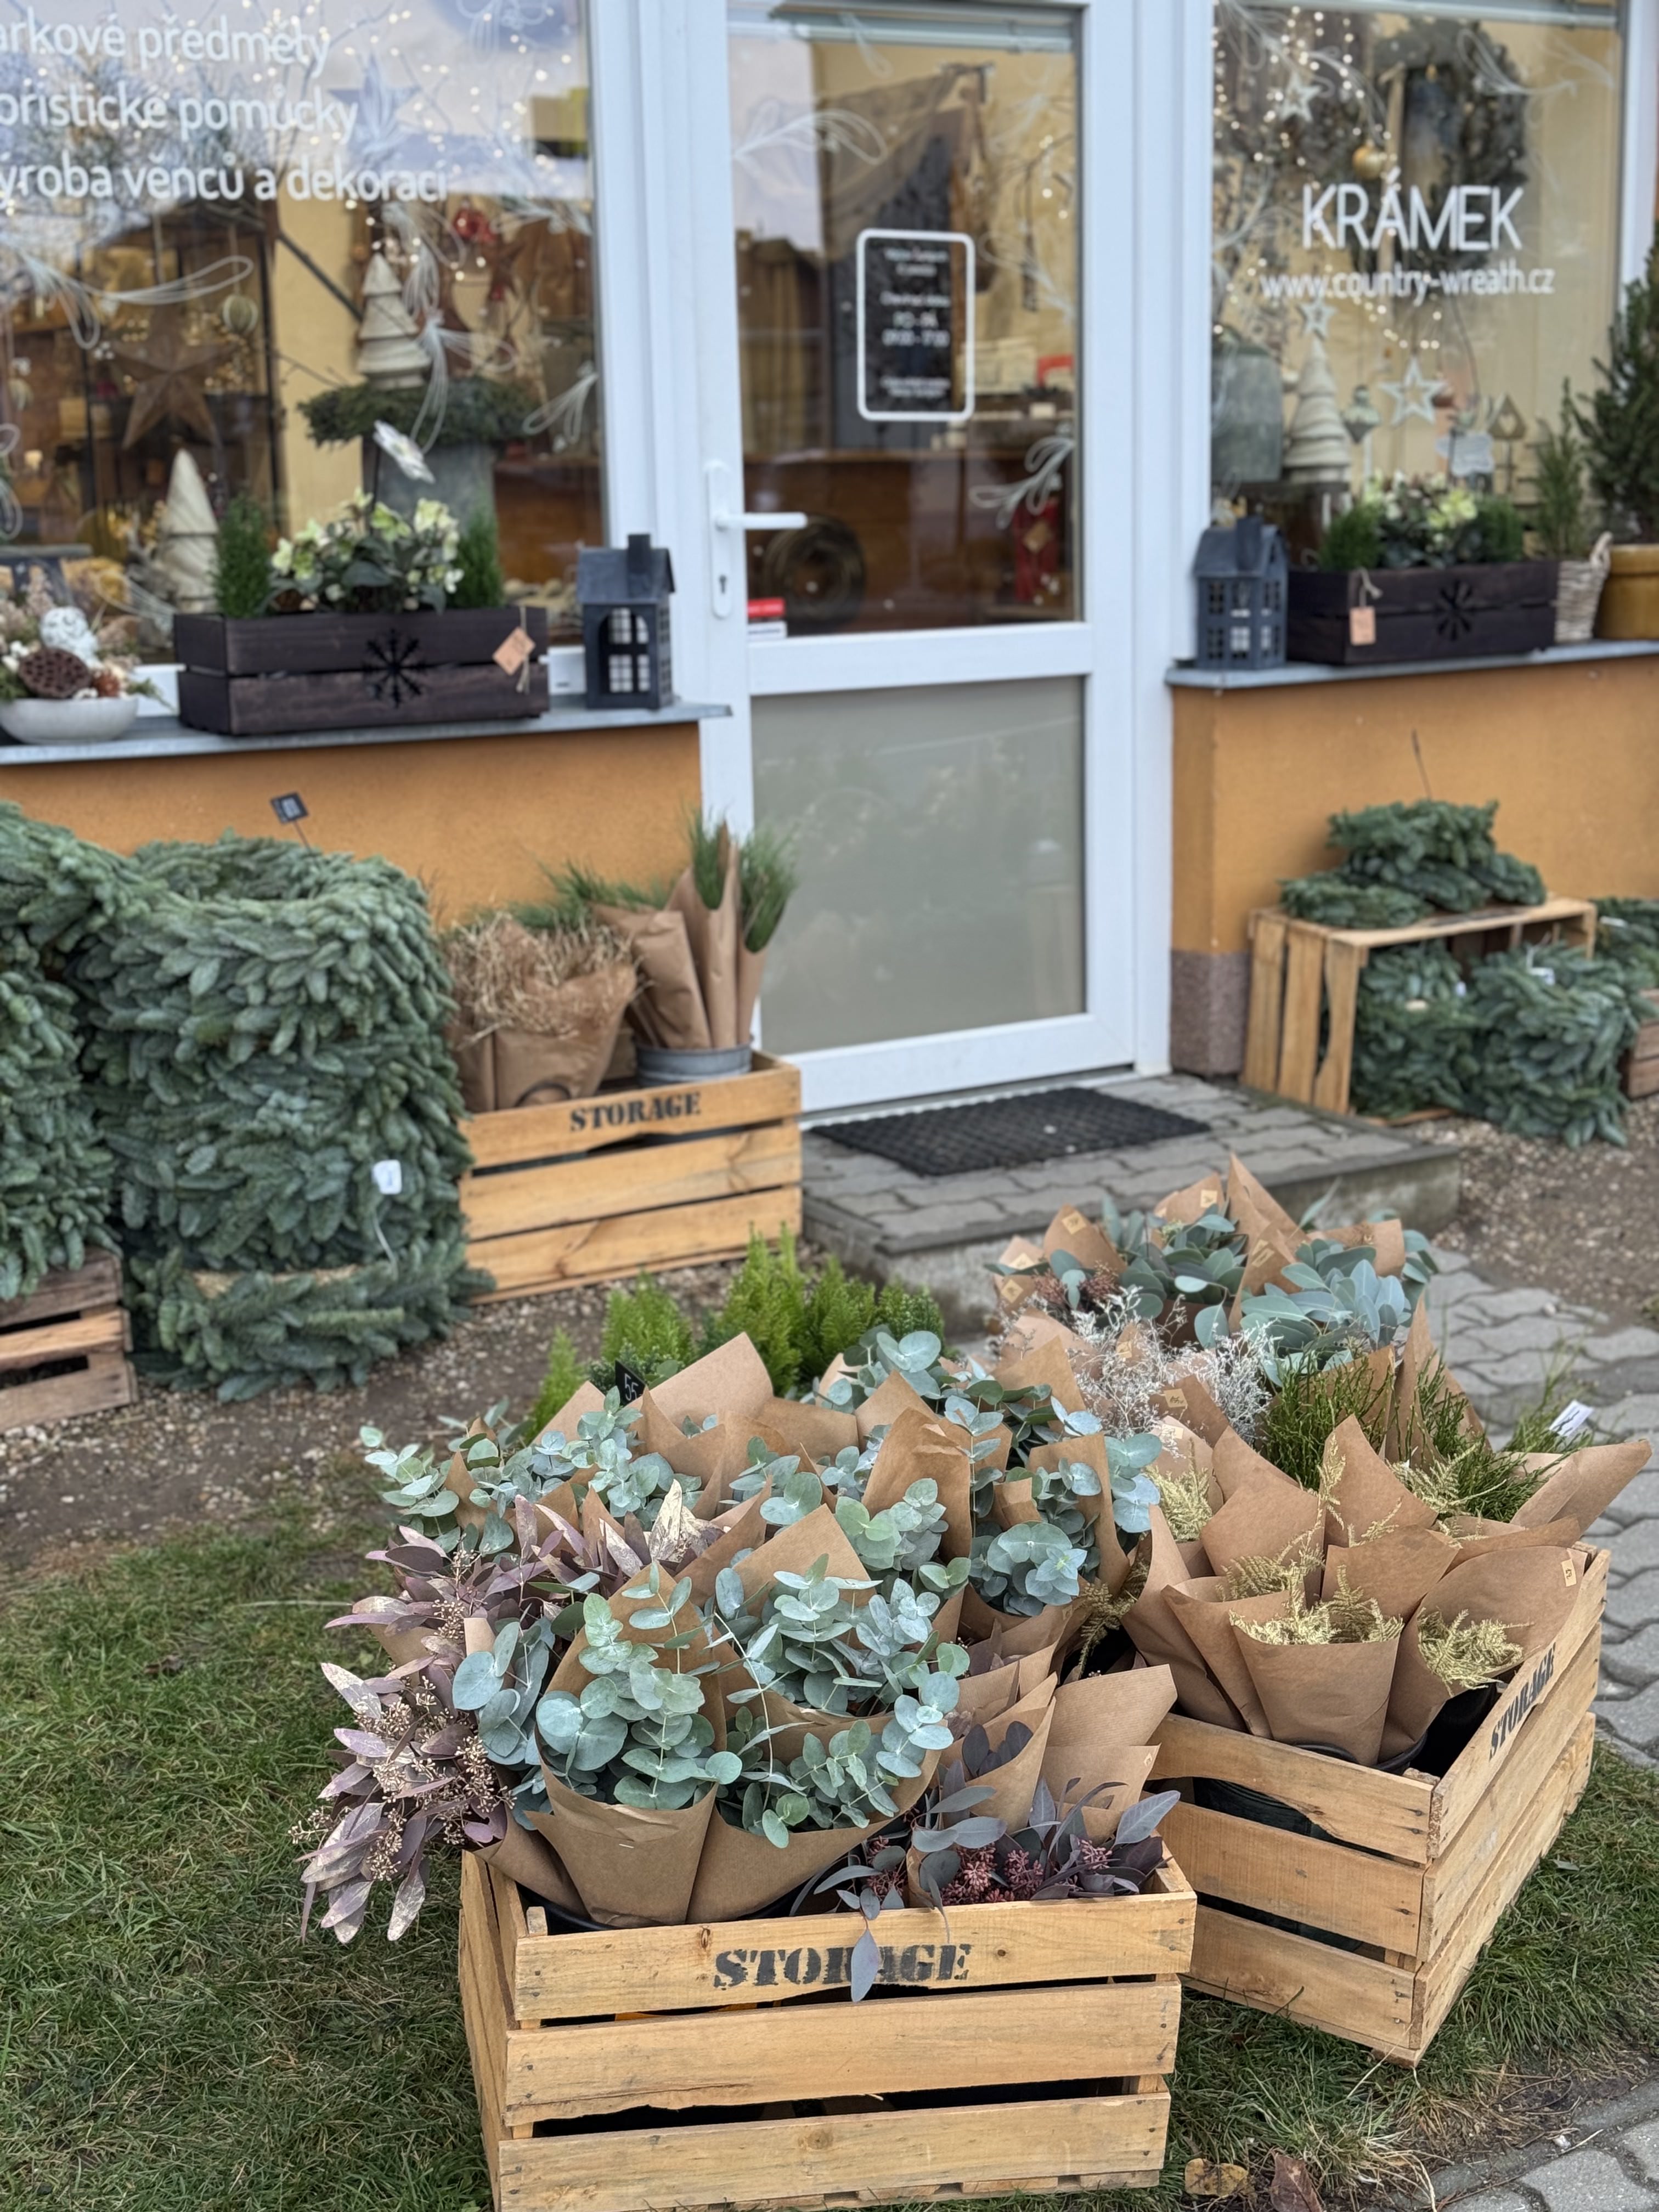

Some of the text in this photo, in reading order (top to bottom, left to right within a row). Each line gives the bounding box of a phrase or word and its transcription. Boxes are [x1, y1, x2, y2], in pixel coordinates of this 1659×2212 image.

[138, 15, 330, 77] předměty
[179, 84, 358, 144] pomůcky
[122, 153, 244, 200] věnců
[255, 168, 277, 200] a
[286, 154, 448, 201] dekorací
[1302, 166, 1523, 251] KRÁMEK
[1262, 257, 1555, 306] www.country-wreath.cz
[570, 1091, 701, 1132] STORAGE
[1489, 1642, 1556, 1761] STORAGE
